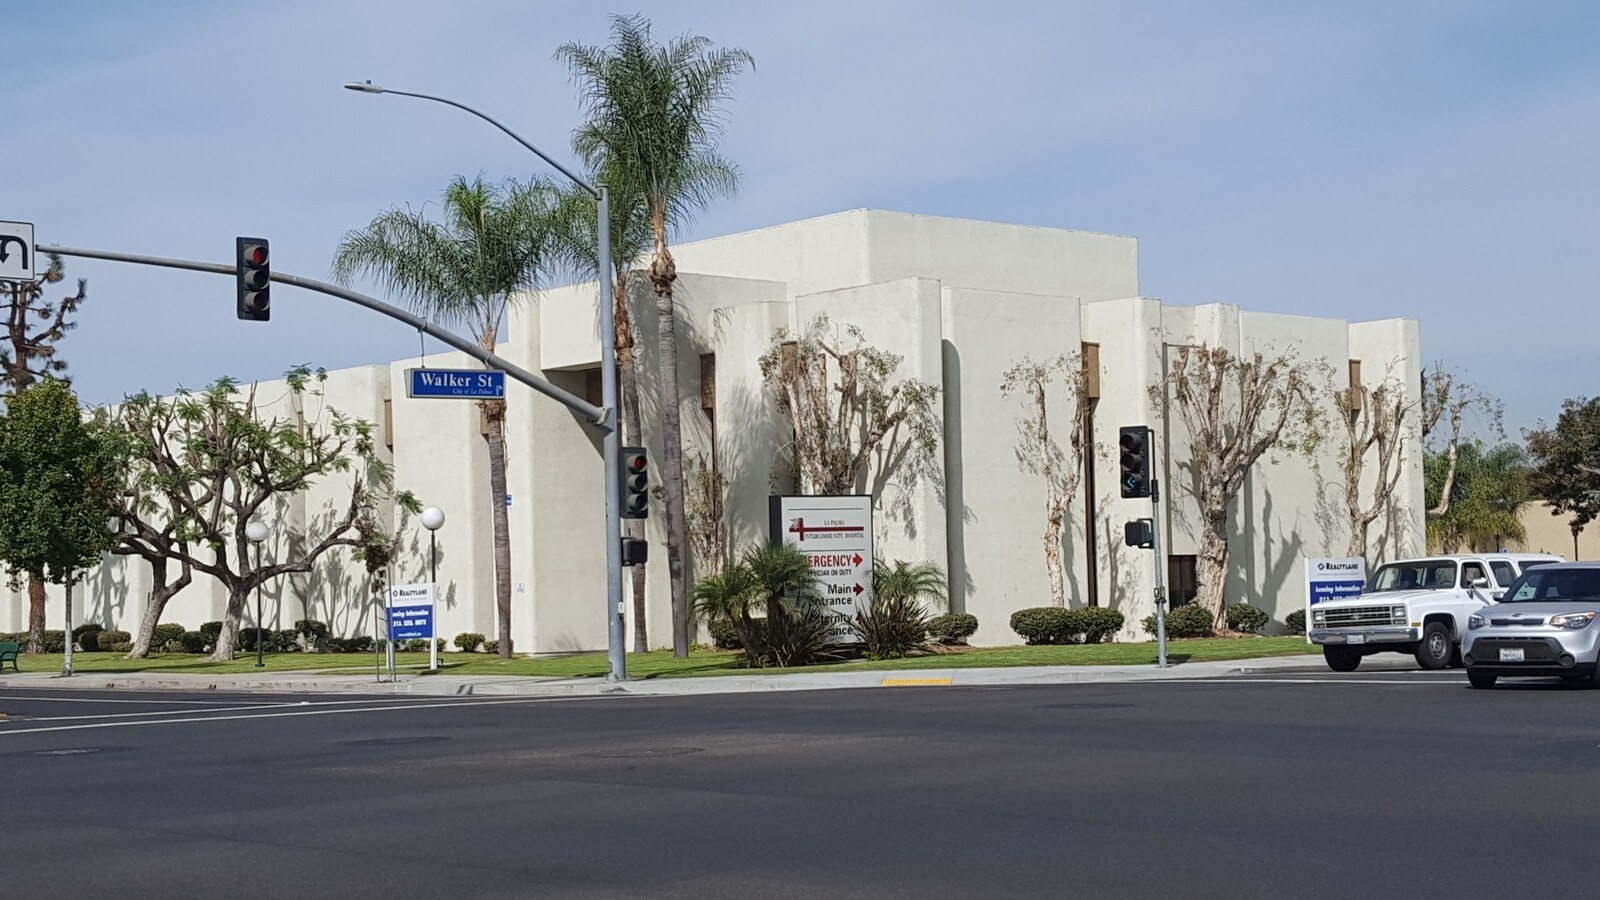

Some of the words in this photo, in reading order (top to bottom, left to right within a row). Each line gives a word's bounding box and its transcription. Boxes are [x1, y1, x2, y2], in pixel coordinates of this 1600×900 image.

[420, 372, 472, 387] Walker
[477, 374, 492, 388] St
[807, 555, 852, 567] ERGENCY
[827, 584, 852, 594] Main
[817, 597, 853, 606] ntrance
